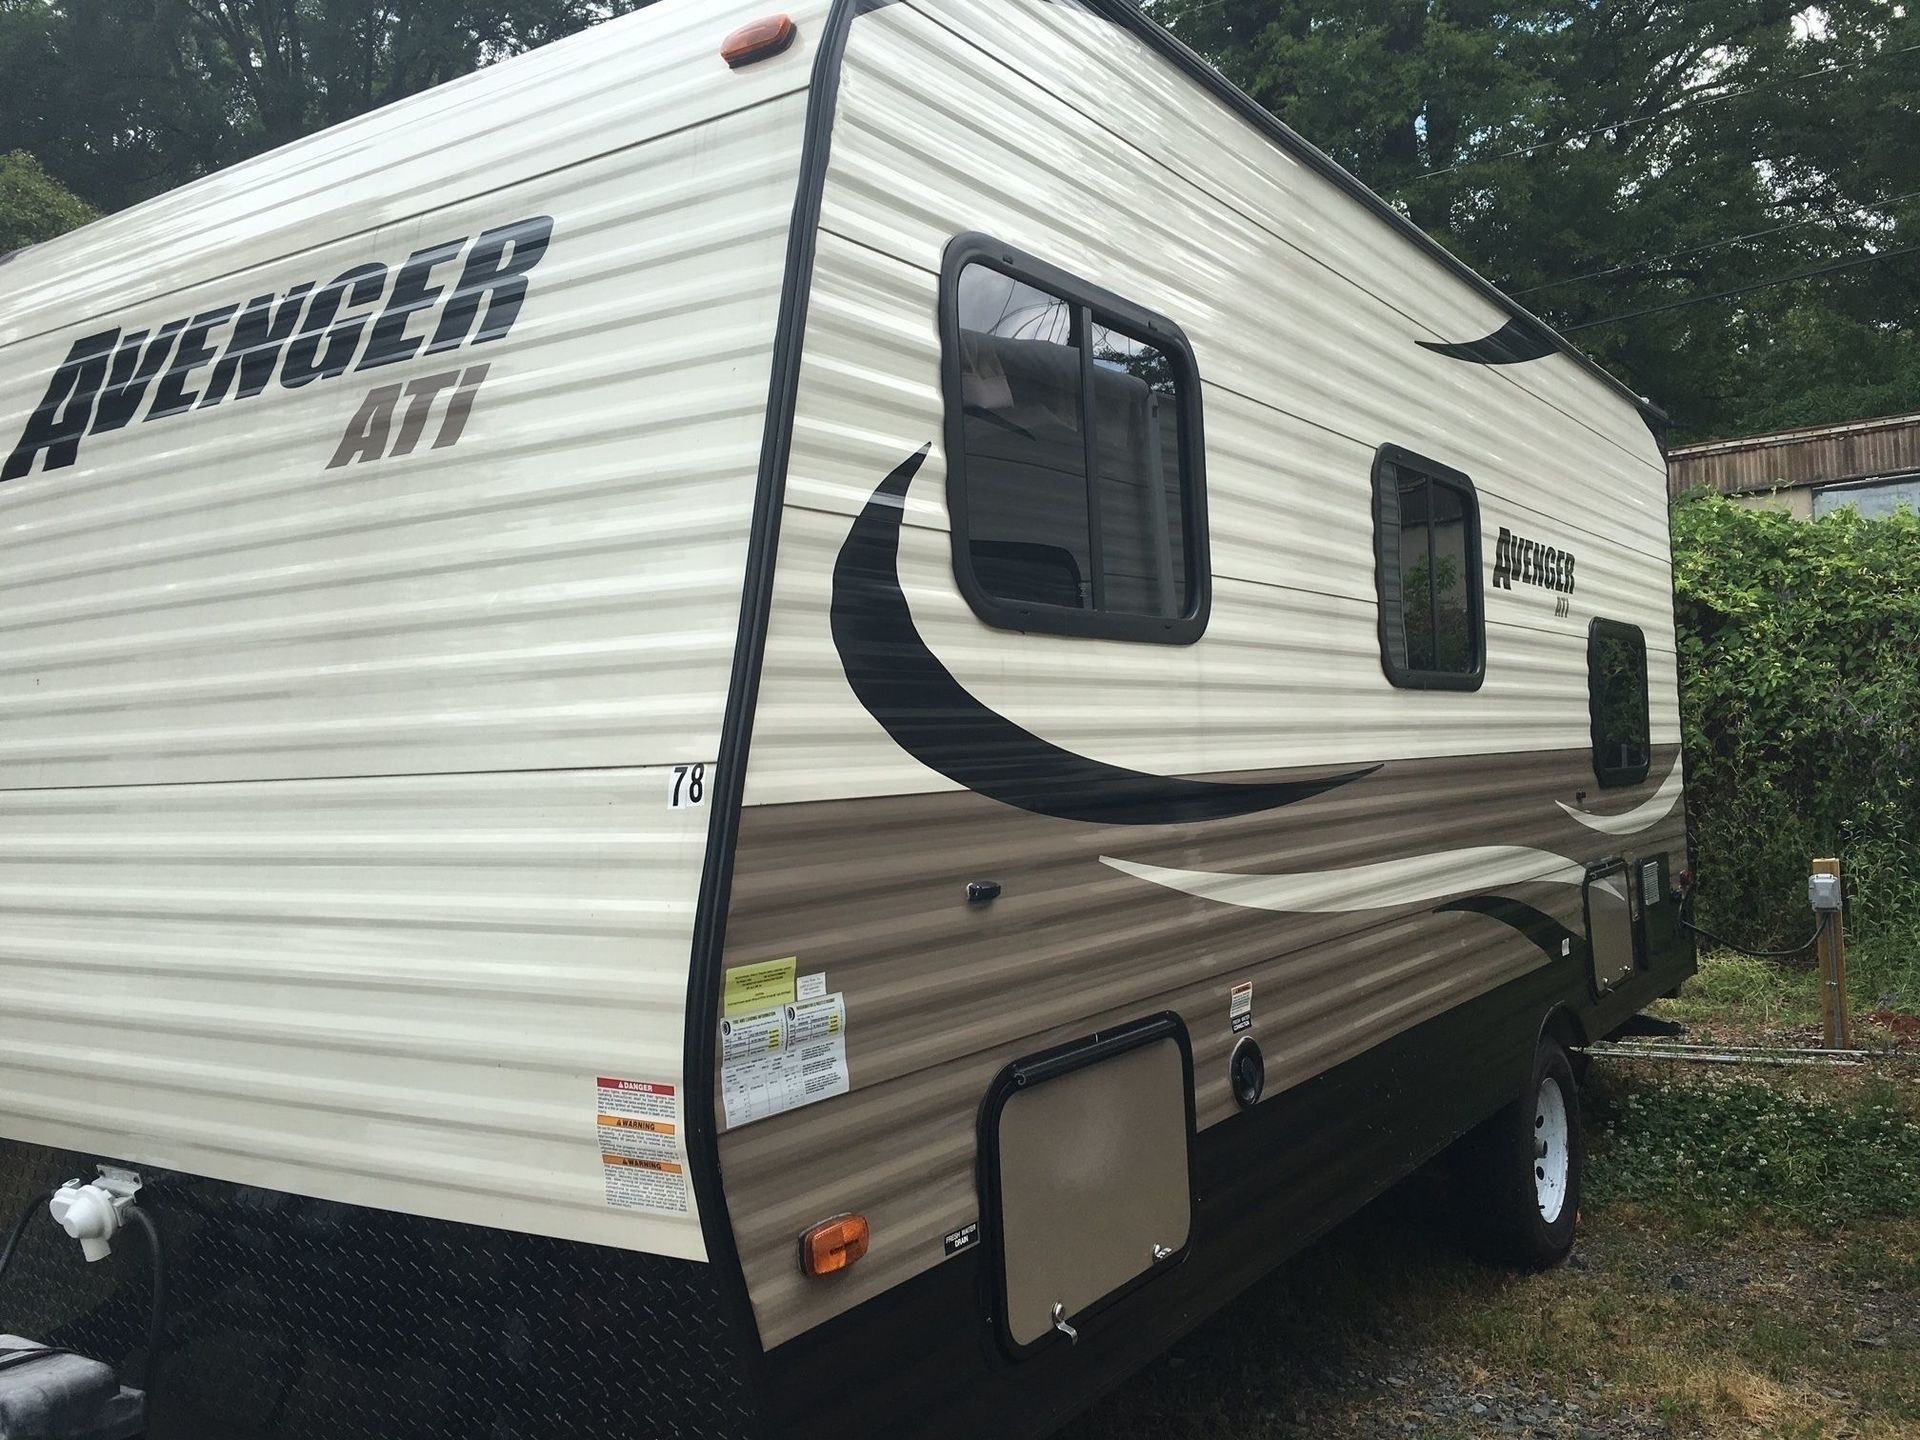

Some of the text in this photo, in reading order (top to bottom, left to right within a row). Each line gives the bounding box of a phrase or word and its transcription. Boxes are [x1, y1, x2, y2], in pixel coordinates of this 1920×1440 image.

[0, 215, 554, 482] AVENGER
[325, 363, 491, 470] ATI
[1492, 526, 1576, 595] AVENGER
[672, 763, 705, 806] 78
[623, 1082, 653, 1093] DANGER
[621, 1119, 656, 1131] WARNING
[628, 1160, 662, 1171] WARNING
